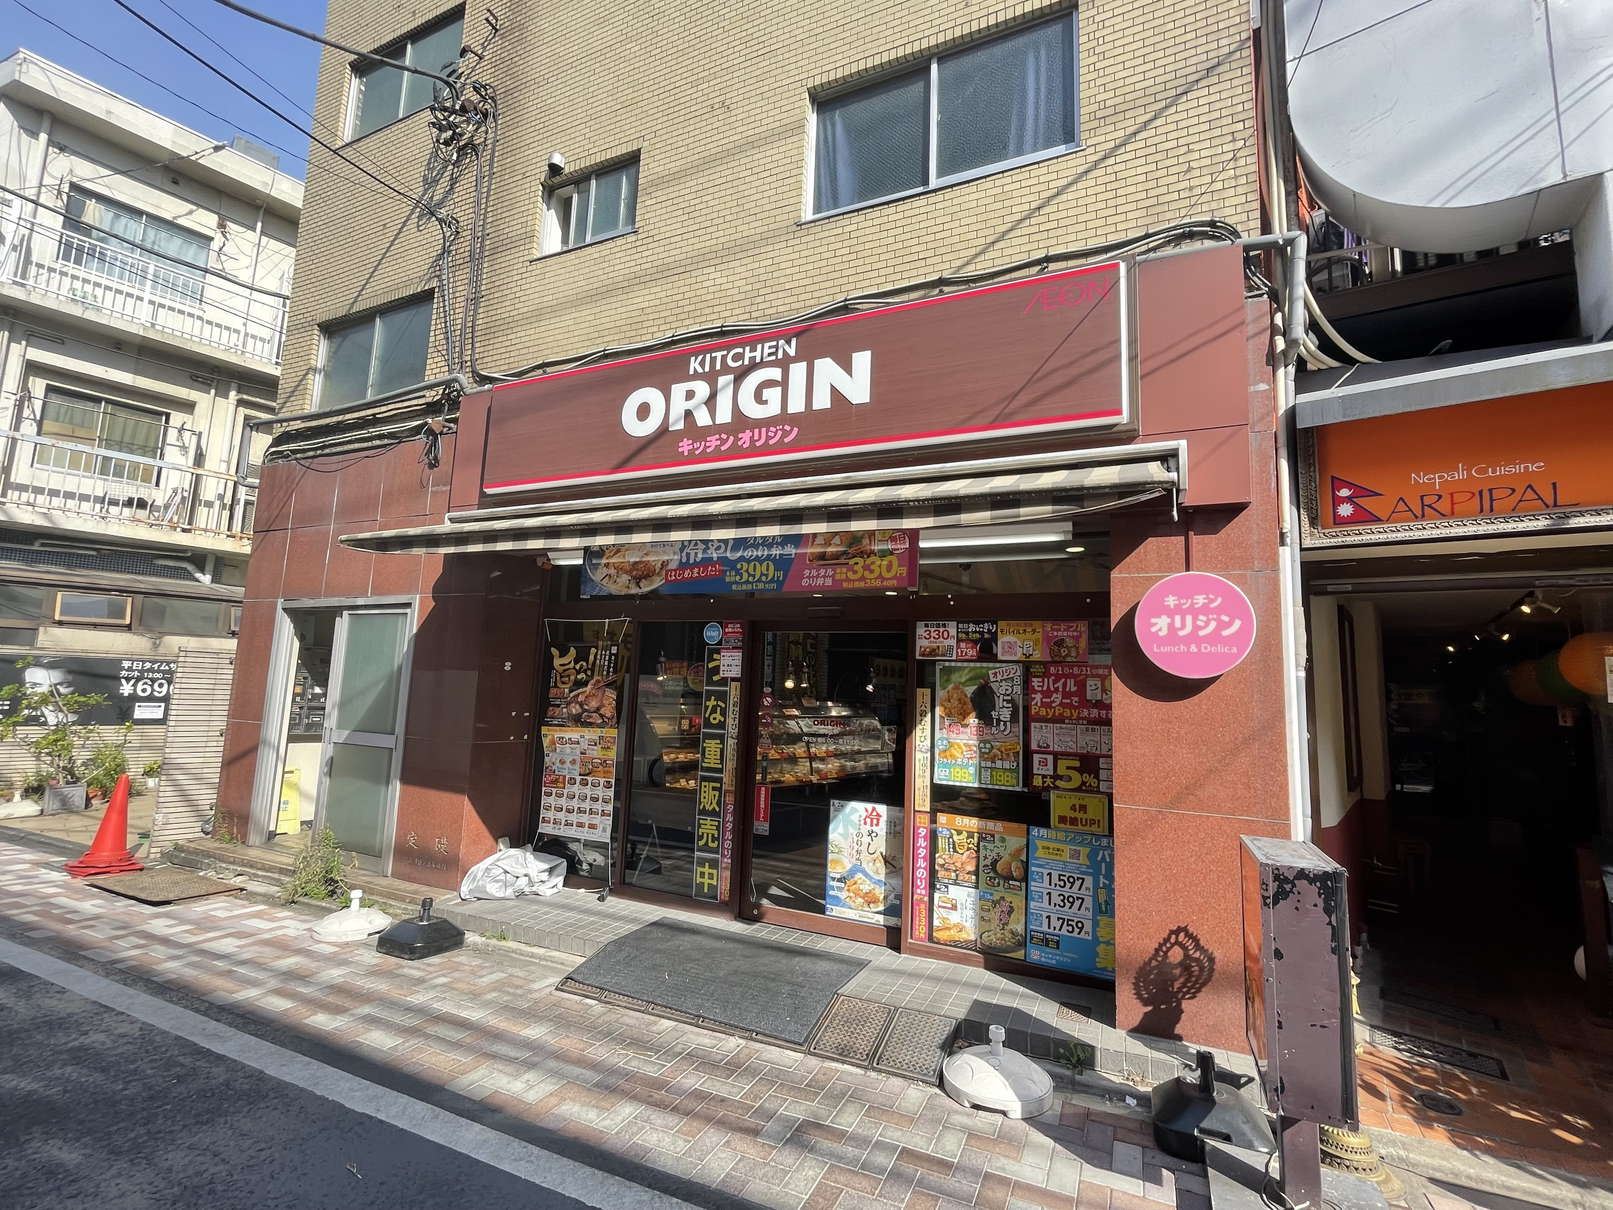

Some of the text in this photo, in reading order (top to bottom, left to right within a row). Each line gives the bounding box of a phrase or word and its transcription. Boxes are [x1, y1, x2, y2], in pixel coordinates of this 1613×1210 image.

[688, 337, 797, 375] KITCHEN
[621, 350, 872, 438] ORIGIN
[678, 424, 799, 456] キッチン オリジン
[1410, 459, 1545, 490] Nepali Cuisine
[1163, 594, 1223, 609] キッチン
[1149, 614, 1243, 637] オリジン
[1153, 643, 1238, 654] Lunch & Delica
[1031, 676, 1078, 692] モバイル
